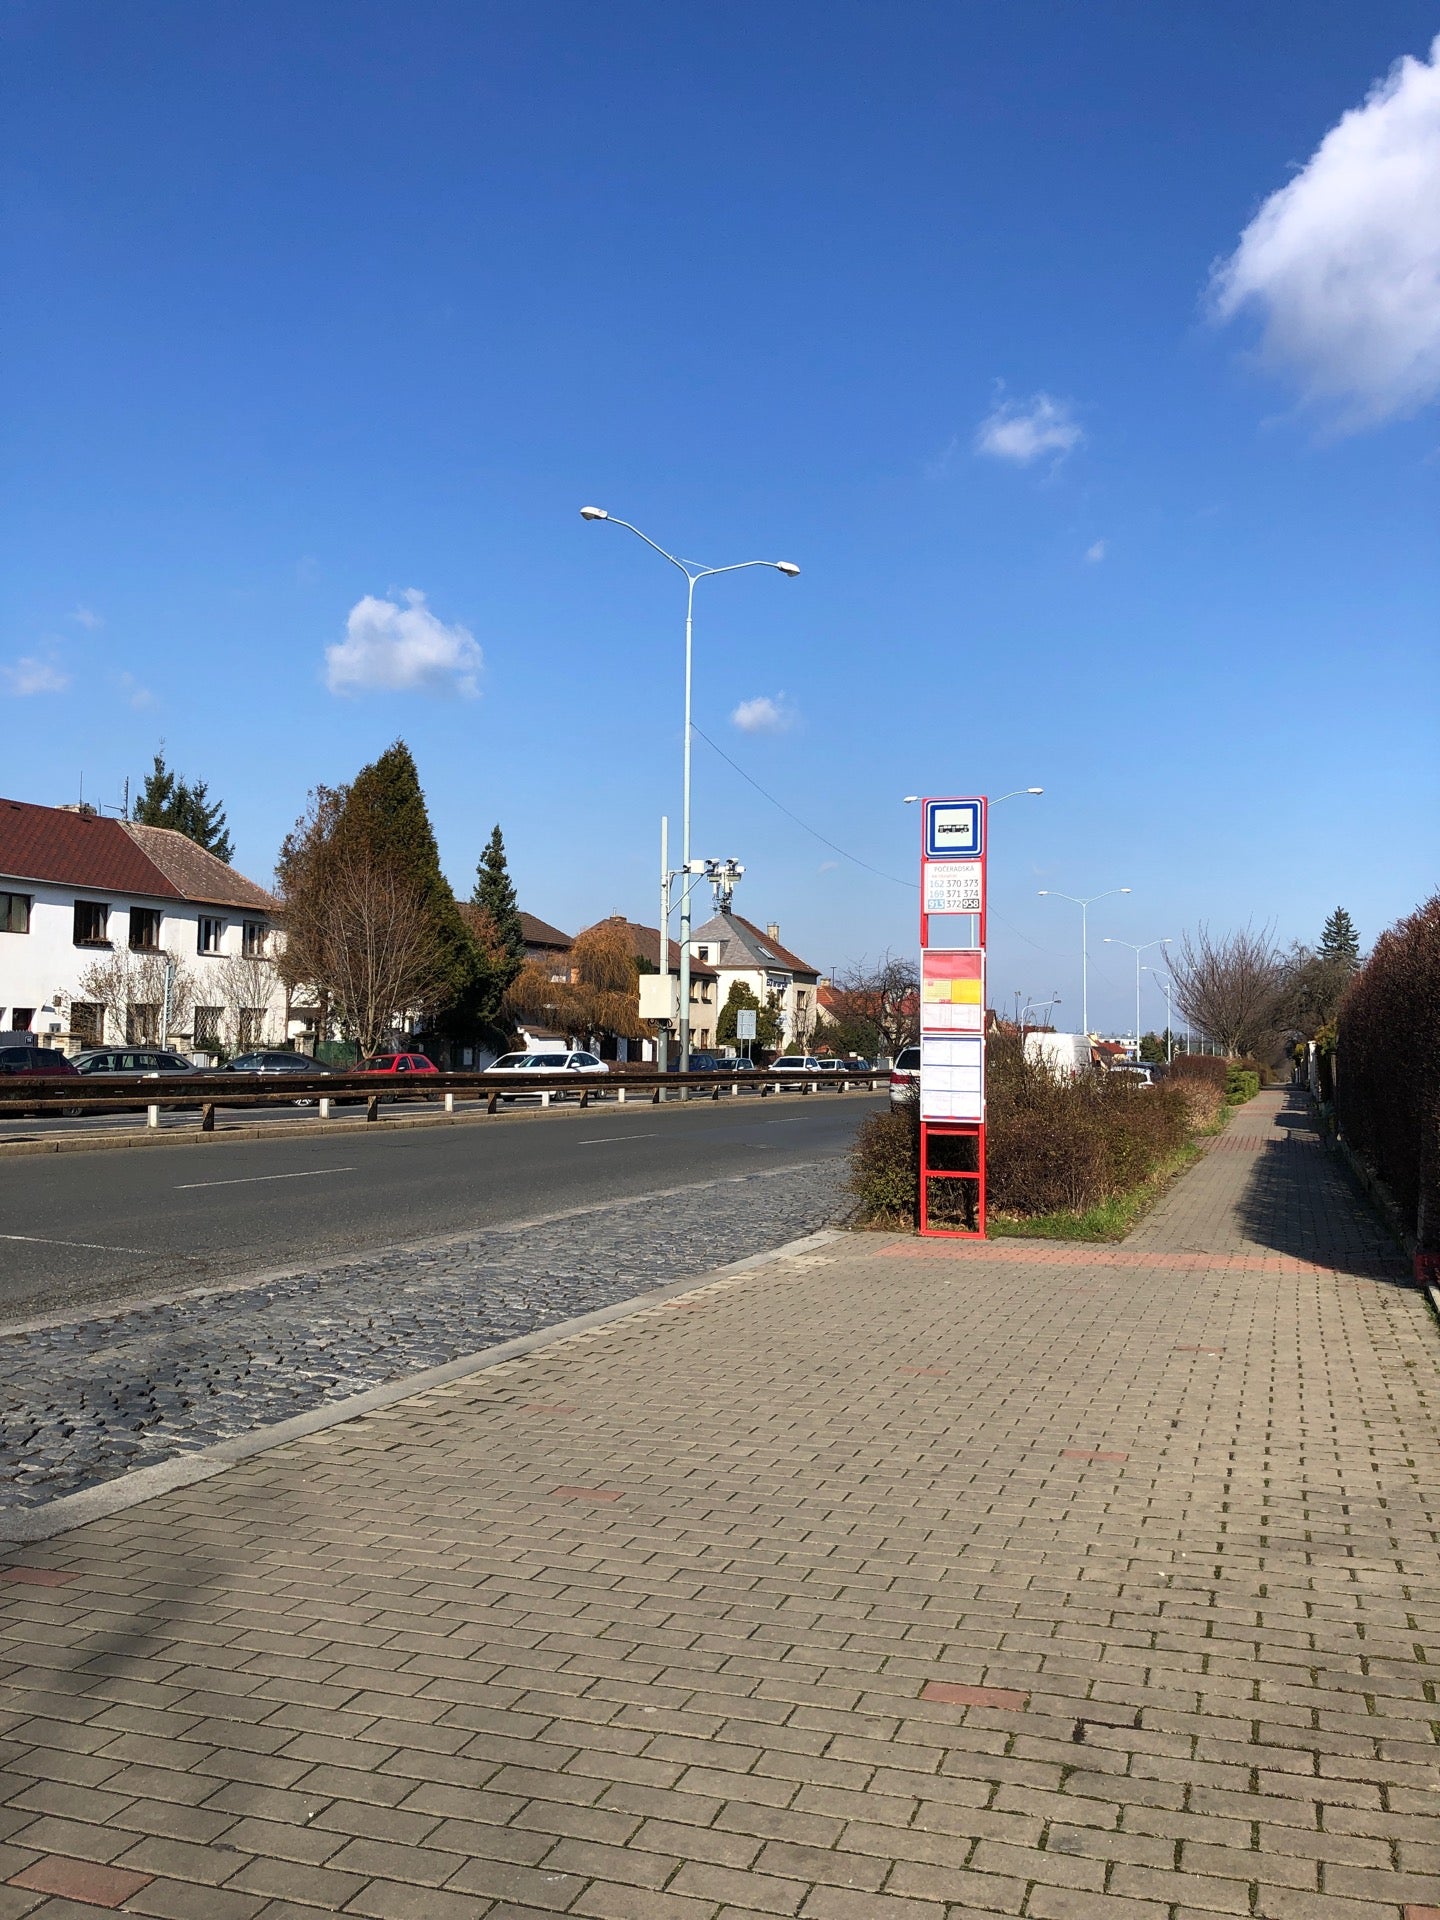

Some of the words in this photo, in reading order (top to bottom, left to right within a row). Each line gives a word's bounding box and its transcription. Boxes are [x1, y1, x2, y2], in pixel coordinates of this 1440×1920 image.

[964, 879, 978, 887] 373
[964, 890, 978, 898] 374
[963, 900, 978, 908] 958
